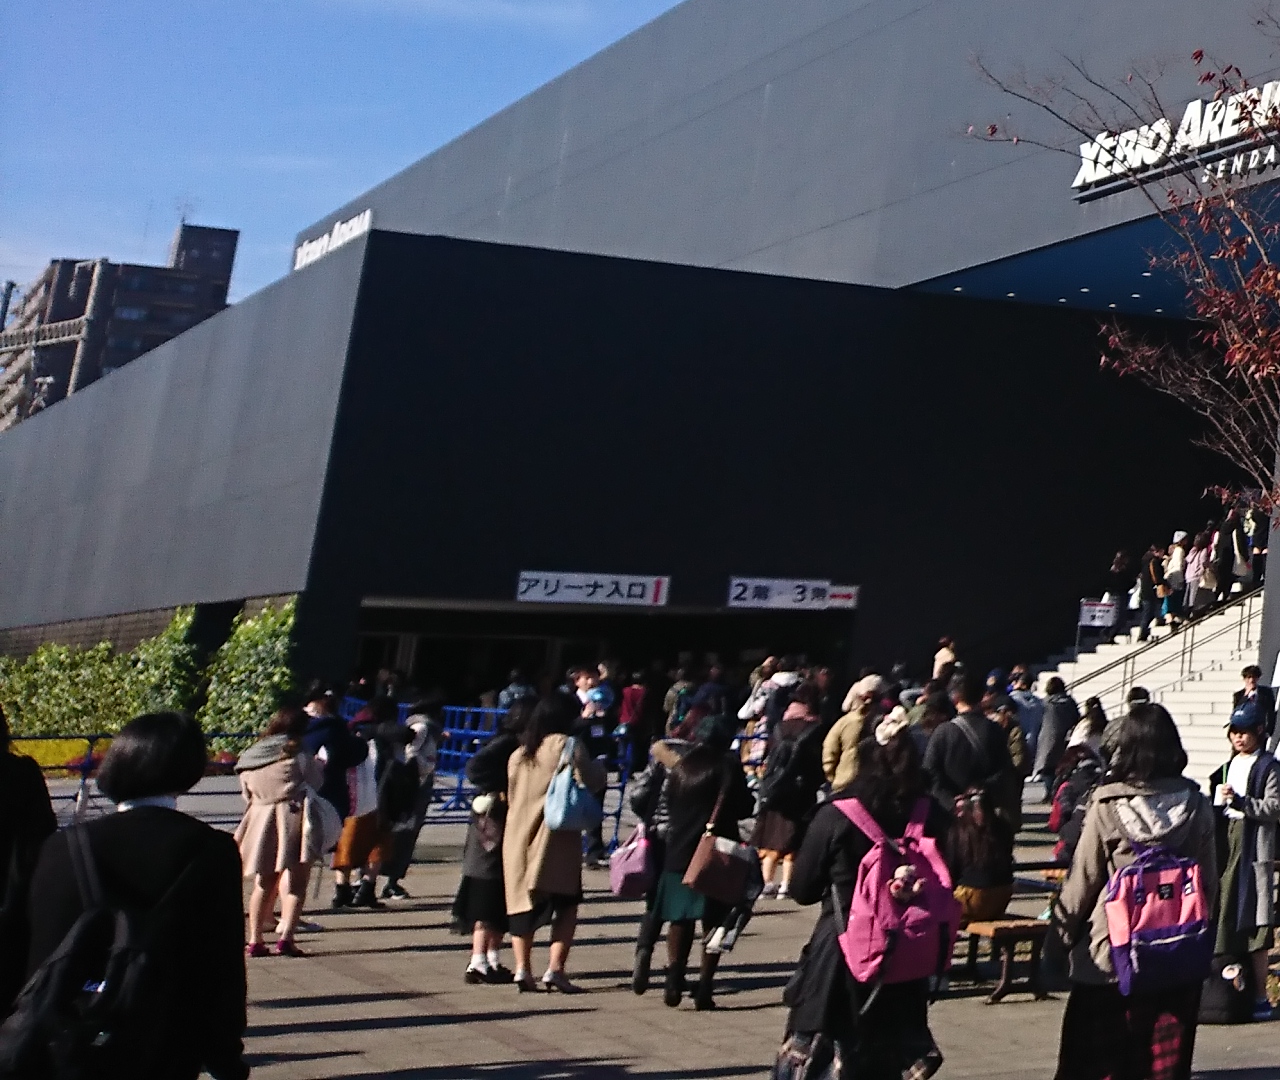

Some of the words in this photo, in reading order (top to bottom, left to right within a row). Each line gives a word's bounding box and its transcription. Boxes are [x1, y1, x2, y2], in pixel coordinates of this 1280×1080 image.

[519, 577, 647, 600] アリーナ入口
